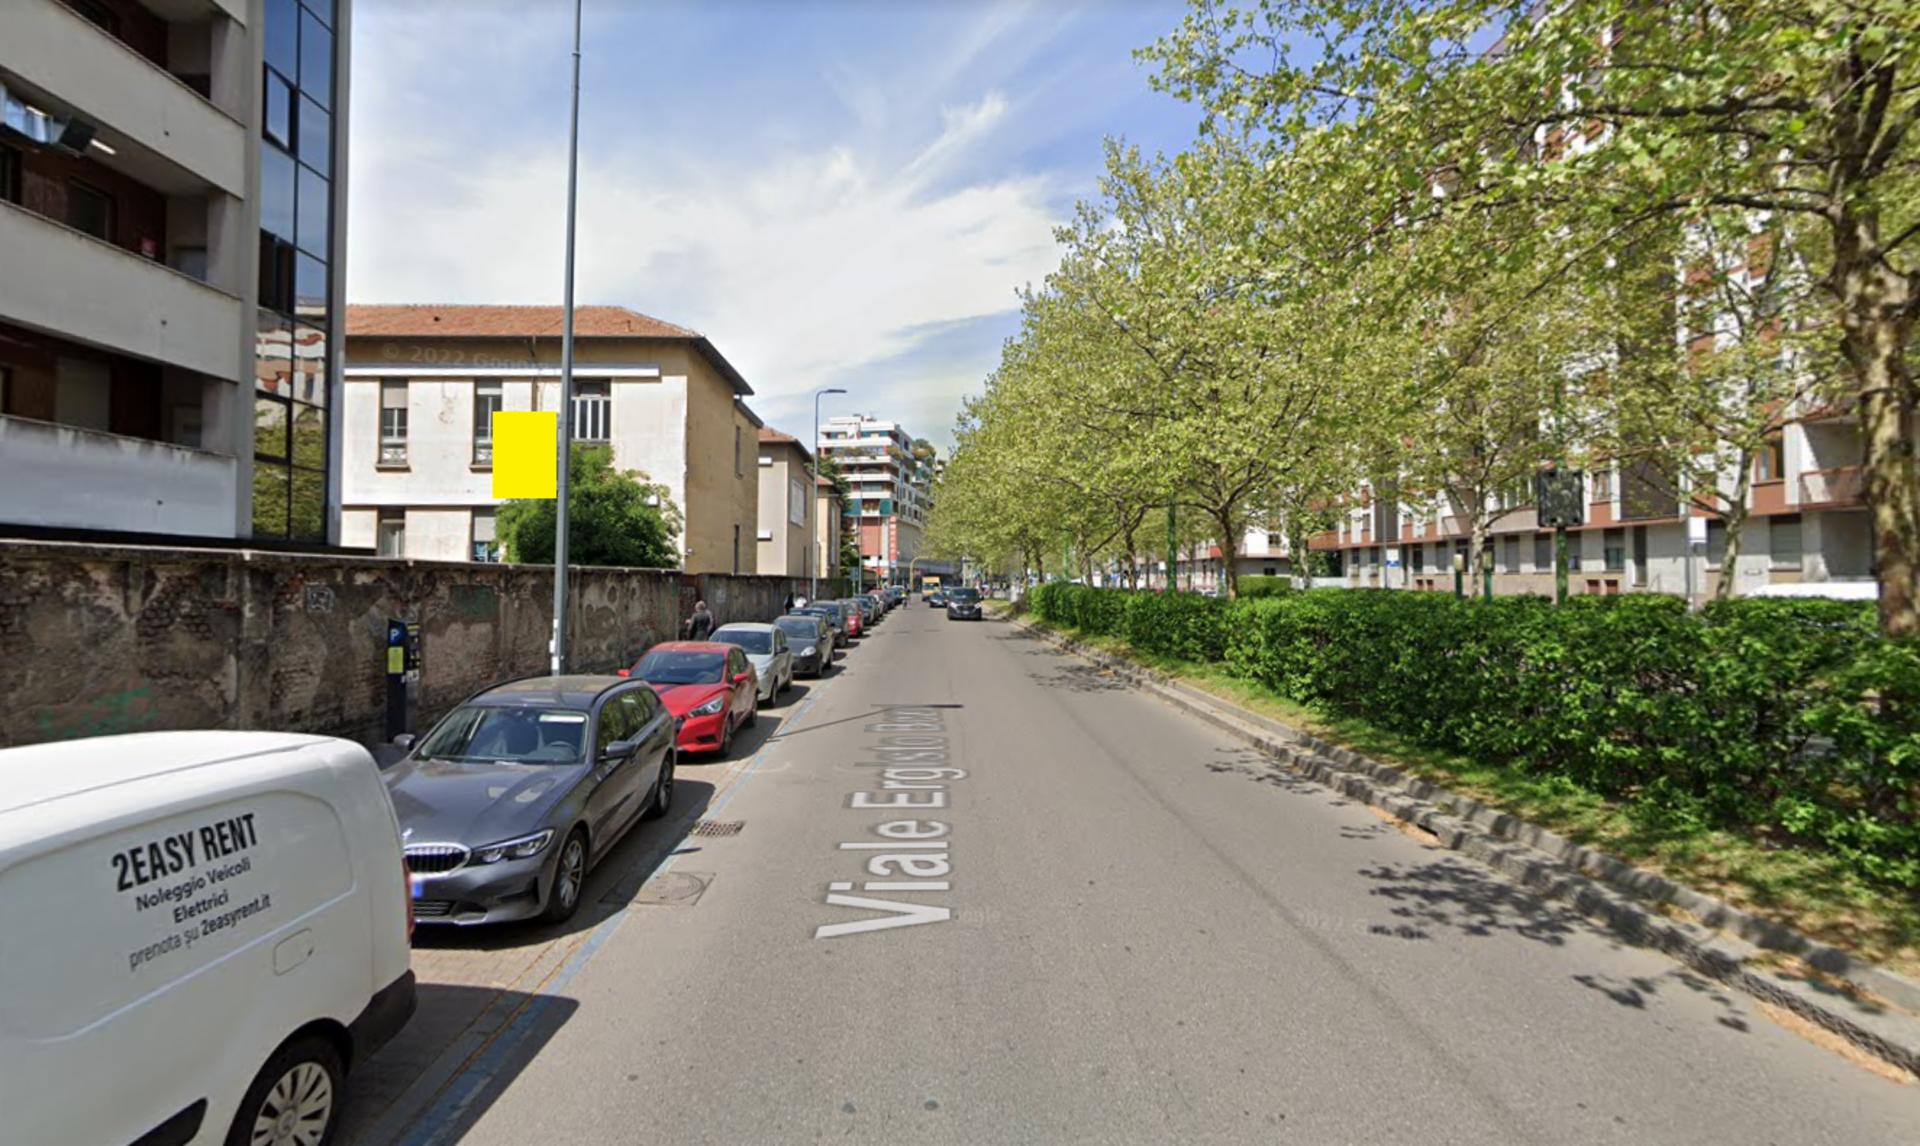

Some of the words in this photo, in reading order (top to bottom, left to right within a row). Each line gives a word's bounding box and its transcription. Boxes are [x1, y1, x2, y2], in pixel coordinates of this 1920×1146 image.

[112, 831, 196, 892] 2EASY
[199, 813, 257, 861] RENT
[136, 875, 206, 911] Noleggio
[206, 857, 251, 884] Veicoli
[130, 934, 182, 972] prenota
[200, 893, 271, 936] 2easyrent.it
[173, 889, 229, 923] Elettrici
